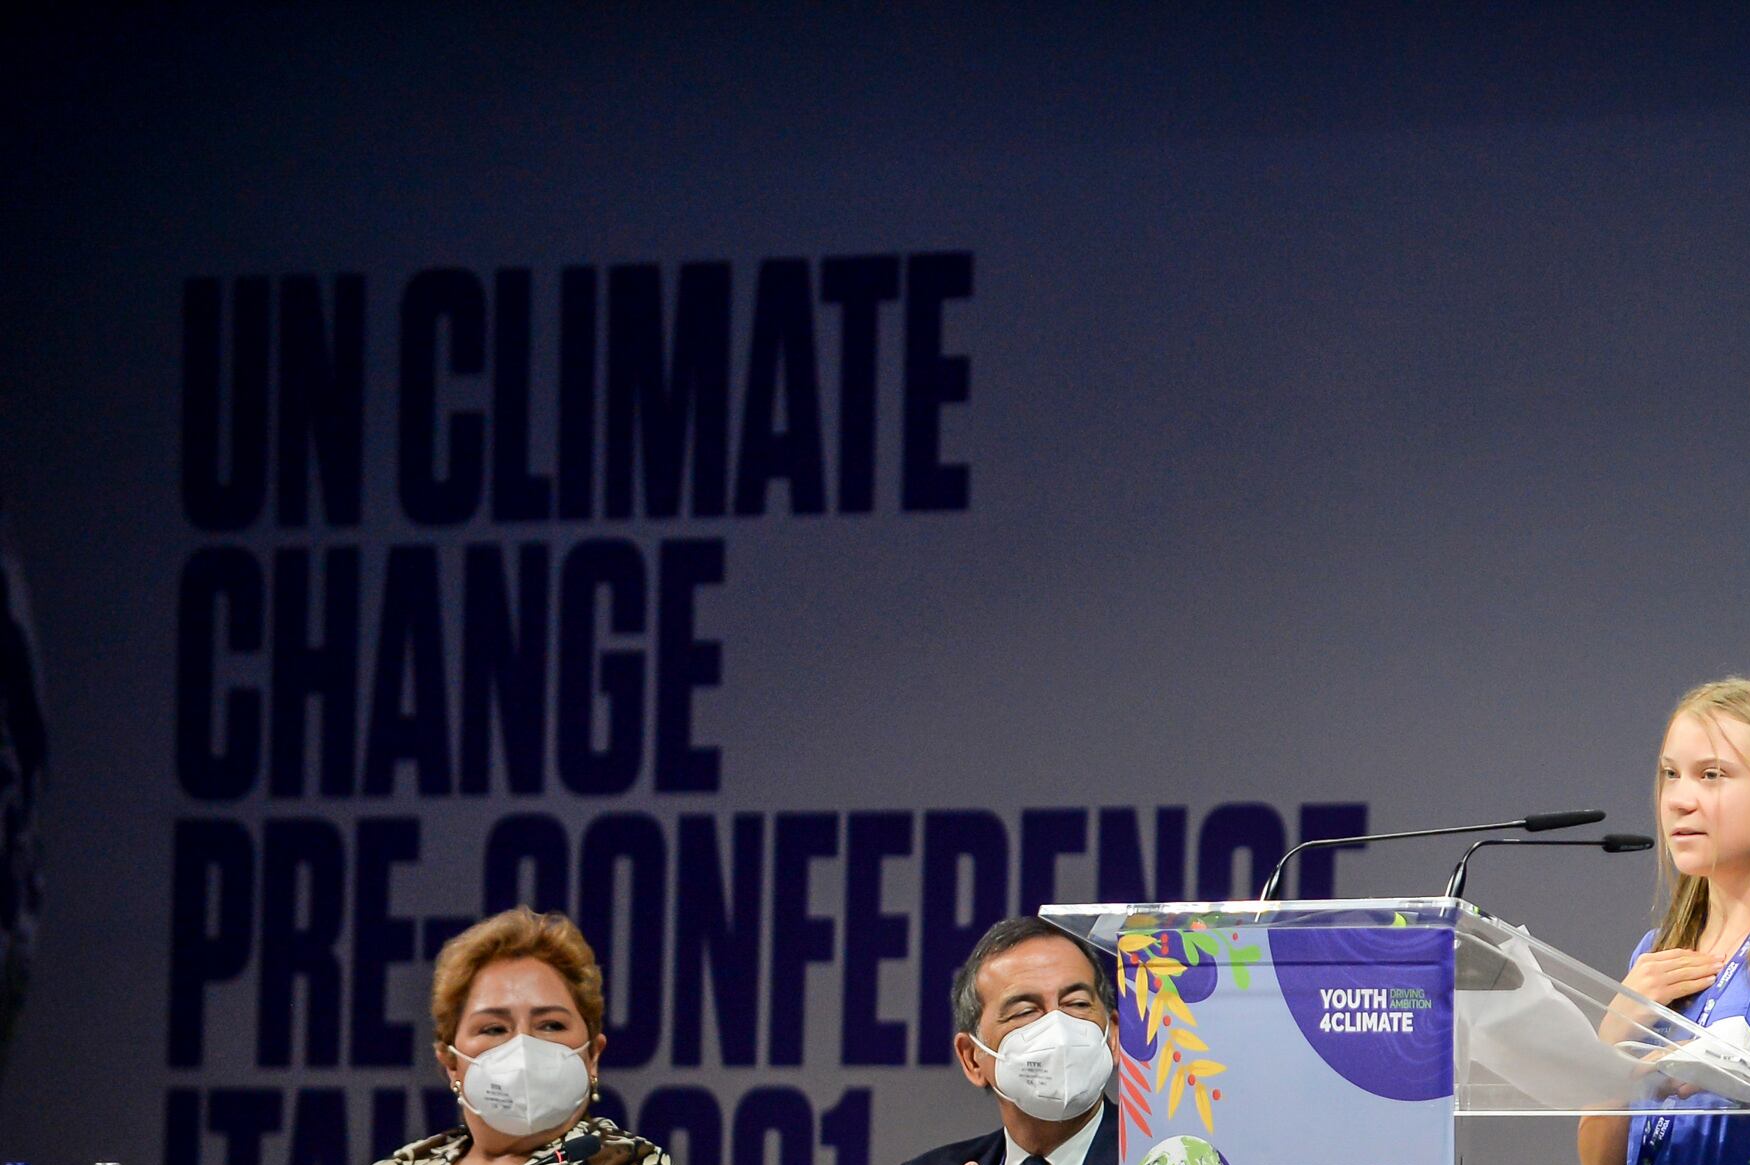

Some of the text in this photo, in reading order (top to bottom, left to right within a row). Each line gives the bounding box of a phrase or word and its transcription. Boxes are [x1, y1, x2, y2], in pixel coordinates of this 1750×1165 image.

[180, 251, 975, 532] UN CLIMATE
[173, 536, 727, 804] CHANGE
[1320, 988, 1387, 1009] YOUTH
[1389, 988, 1425, 999] DRIVING
[1389, 999, 1432, 1009] AMBITION
[1320, 1012, 1415, 1032] 4CLIMATE
